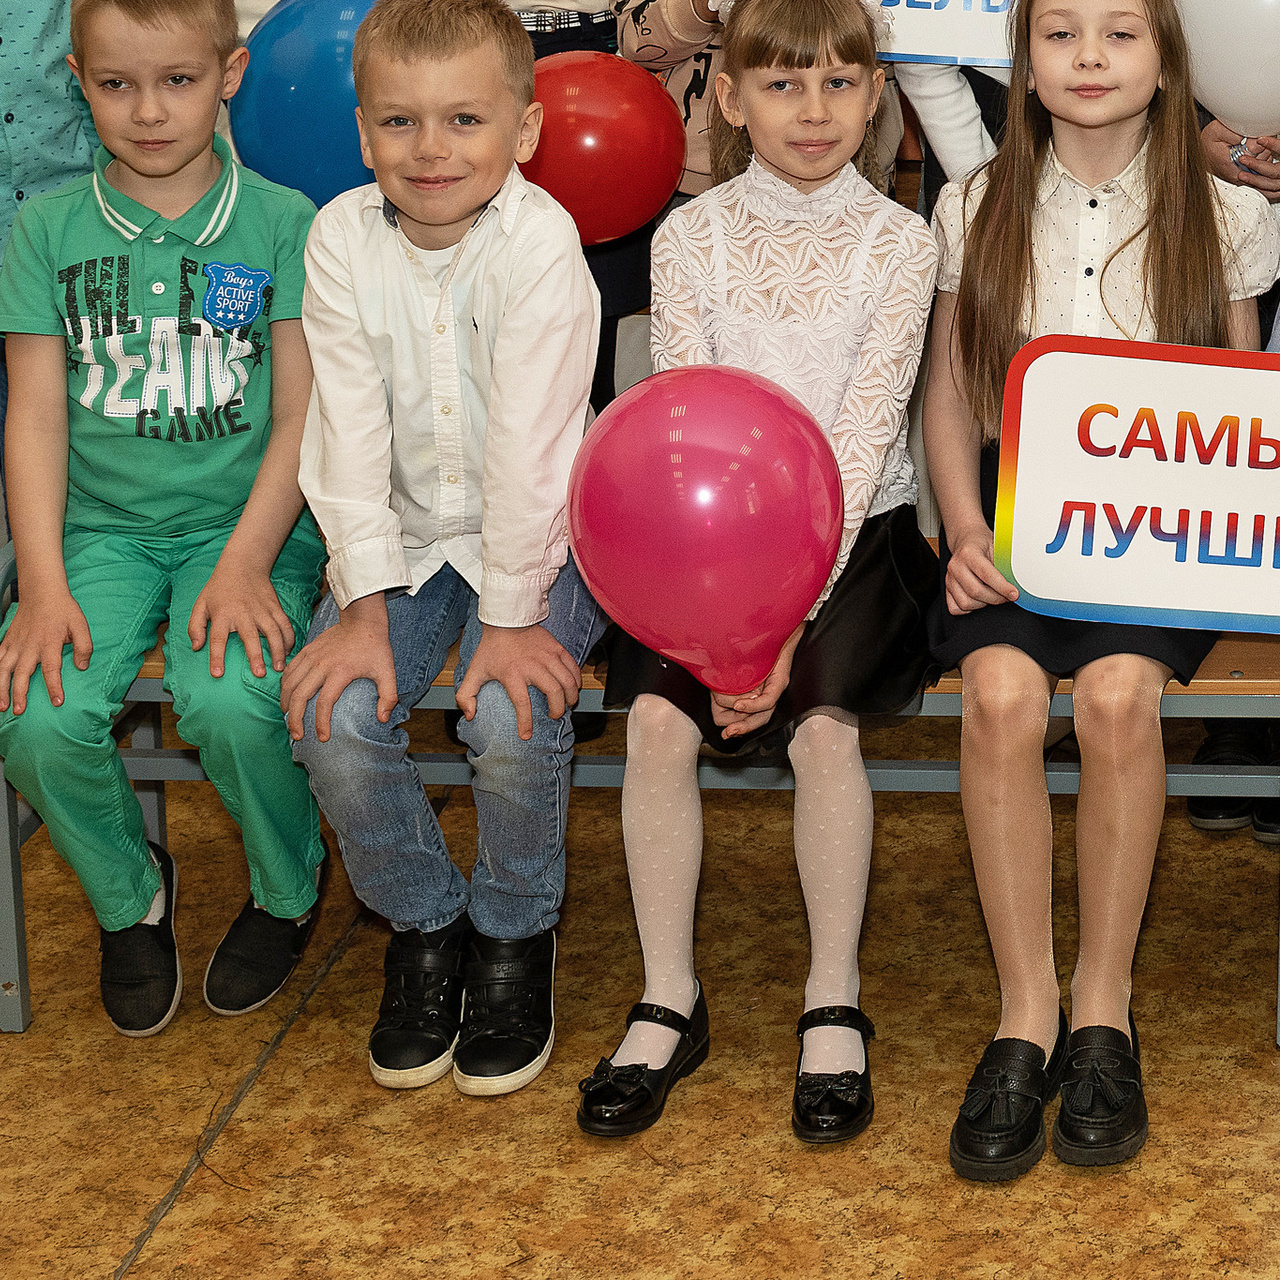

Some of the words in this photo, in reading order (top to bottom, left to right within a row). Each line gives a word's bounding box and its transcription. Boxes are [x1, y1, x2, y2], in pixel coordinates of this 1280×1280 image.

[222, 271, 254, 288] Boys
[216, 286, 255, 302] ACTIVE
[216, 297, 251, 312] SPORT
[66, 316, 252, 418] TEAM
[135, 398, 252, 443] GAME
